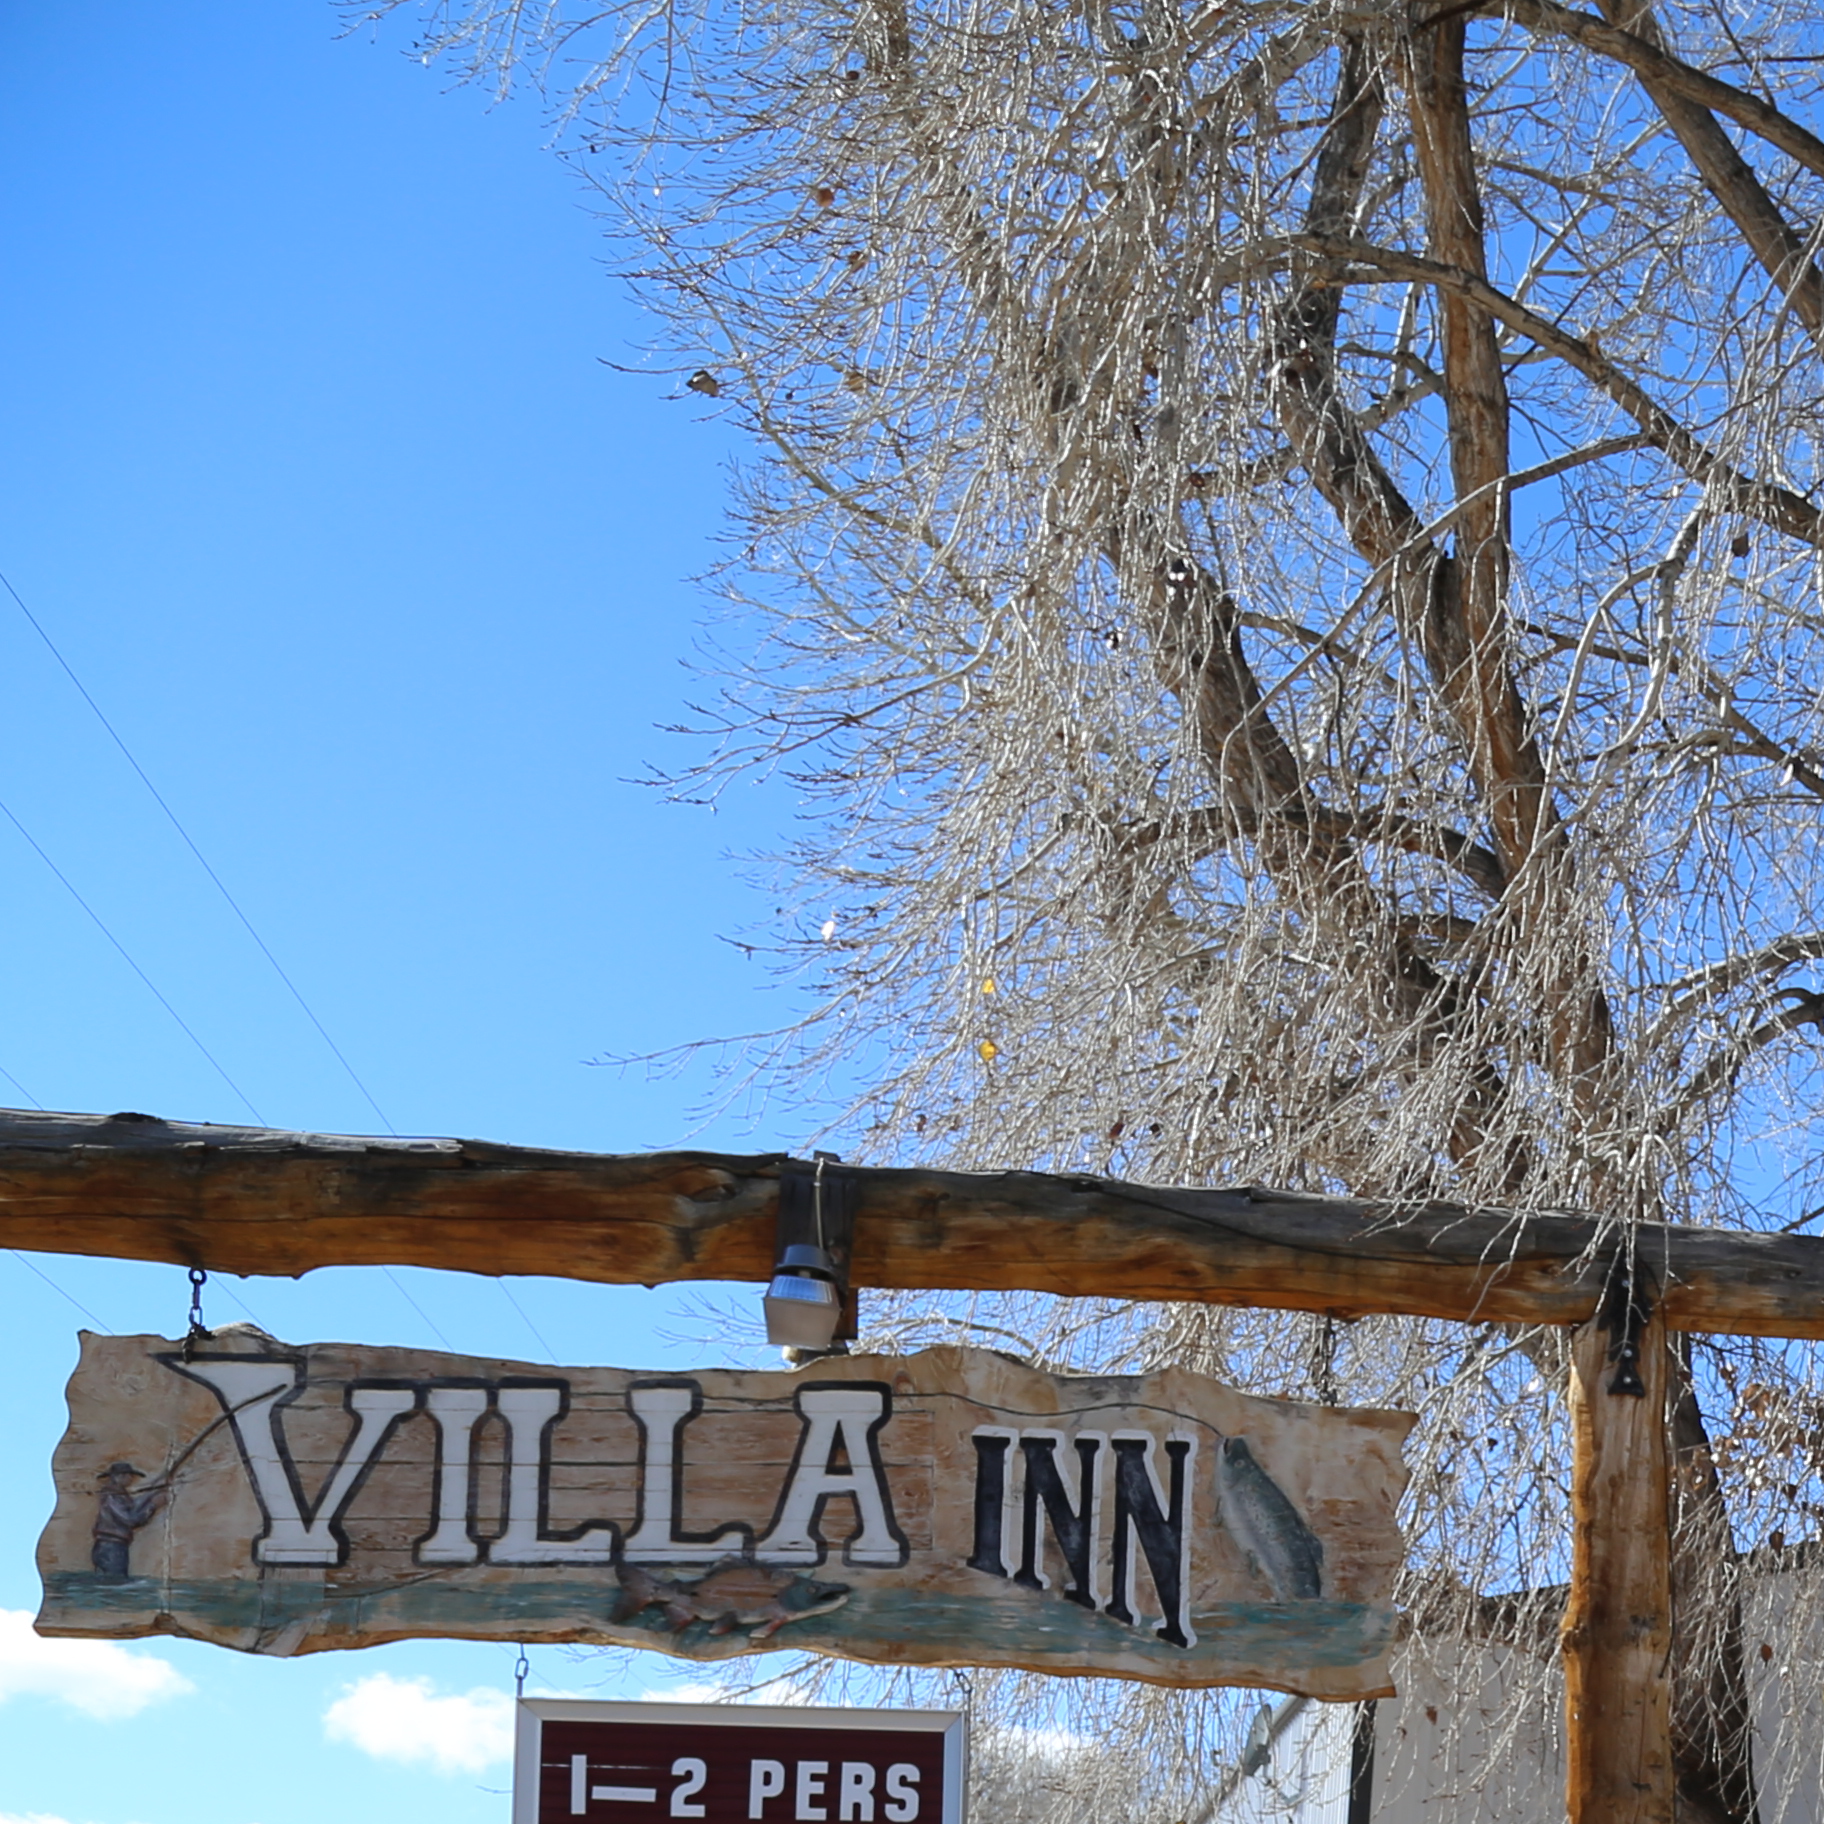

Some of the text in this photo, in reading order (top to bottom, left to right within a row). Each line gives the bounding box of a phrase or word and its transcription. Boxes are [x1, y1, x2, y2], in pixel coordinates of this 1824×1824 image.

[149, 1353, 1198, 1648] VILLA INN
[749, 1759, 921, 1822] PERS
